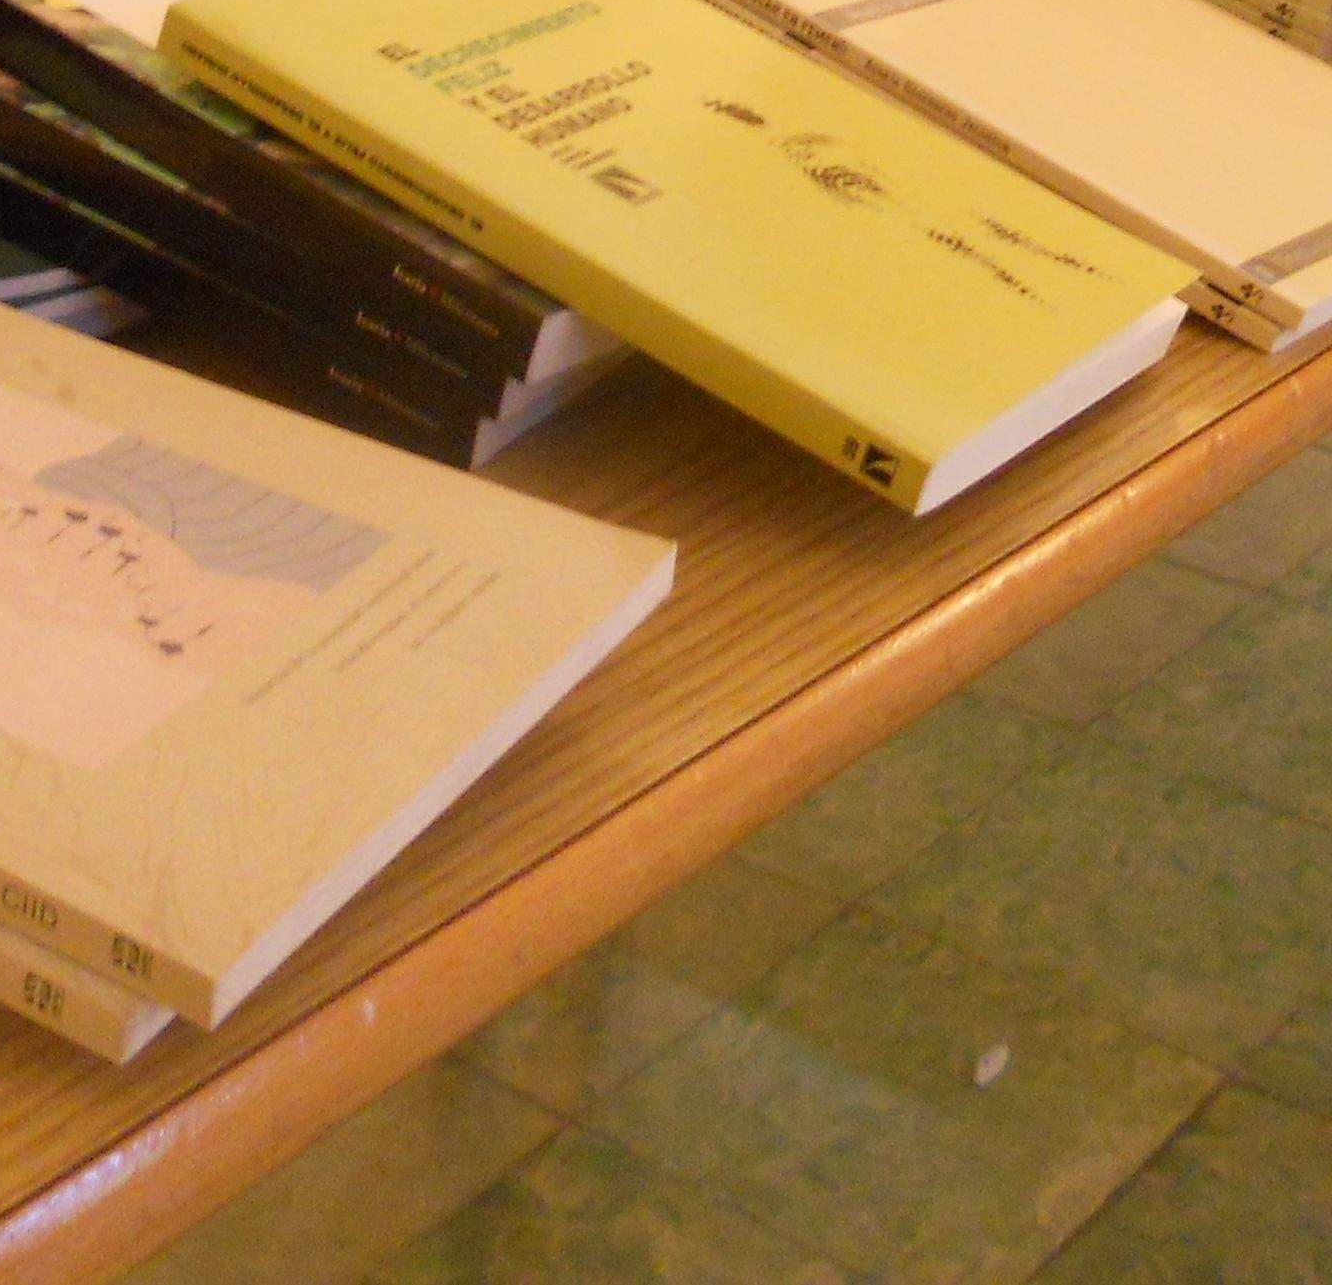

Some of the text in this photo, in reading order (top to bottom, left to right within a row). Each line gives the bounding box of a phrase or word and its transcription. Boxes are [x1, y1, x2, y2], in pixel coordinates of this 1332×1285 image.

[461, 94, 487, 112] Y
[493, 60, 653, 131] DESARROLLO
[522, 96, 633, 149] HUMANO
